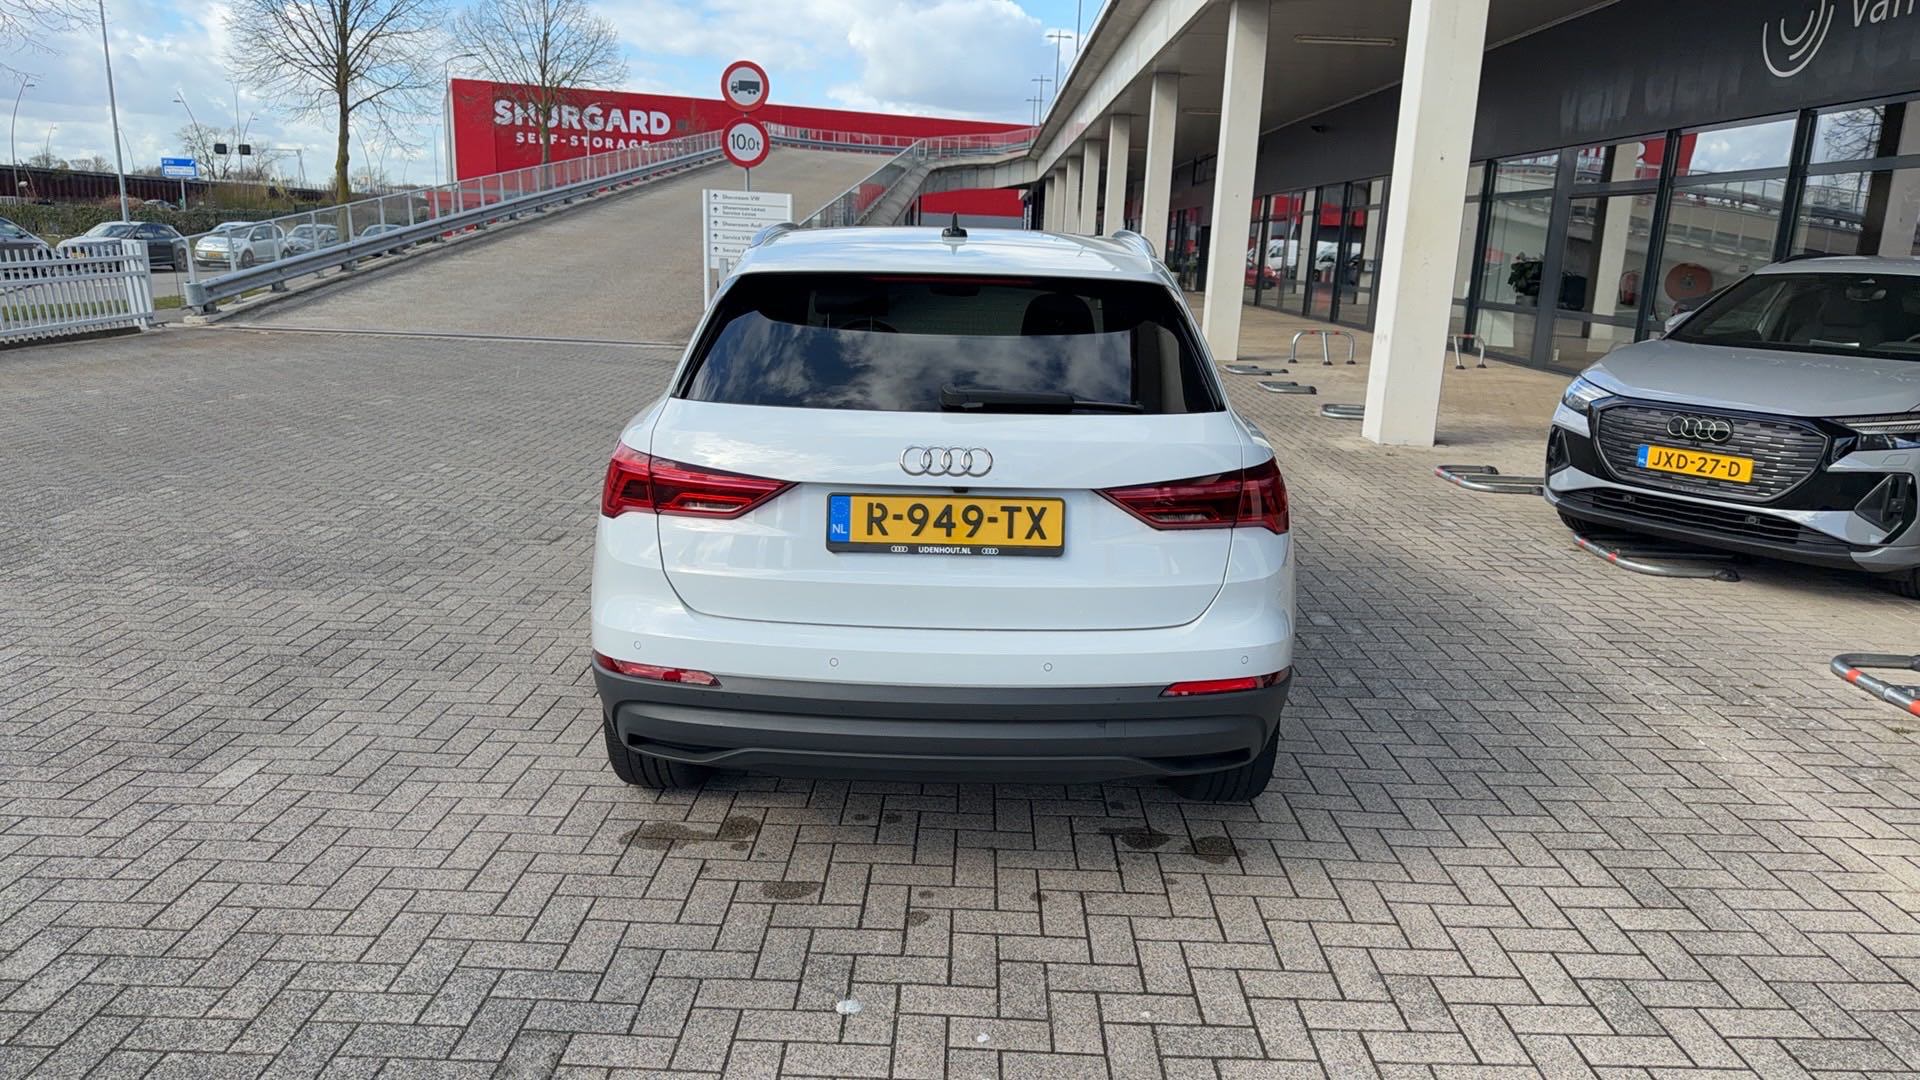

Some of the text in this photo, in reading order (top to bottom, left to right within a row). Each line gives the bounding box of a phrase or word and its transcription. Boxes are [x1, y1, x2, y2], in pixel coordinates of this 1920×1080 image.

[494, 99, 671, 136] SHURGARD
[1652, 450, 1741, 477] JXD-27-D
[832, 502, 1048, 540] NL R-949-TX
[918, 546, 971, 555] UDENHOUT.NL
